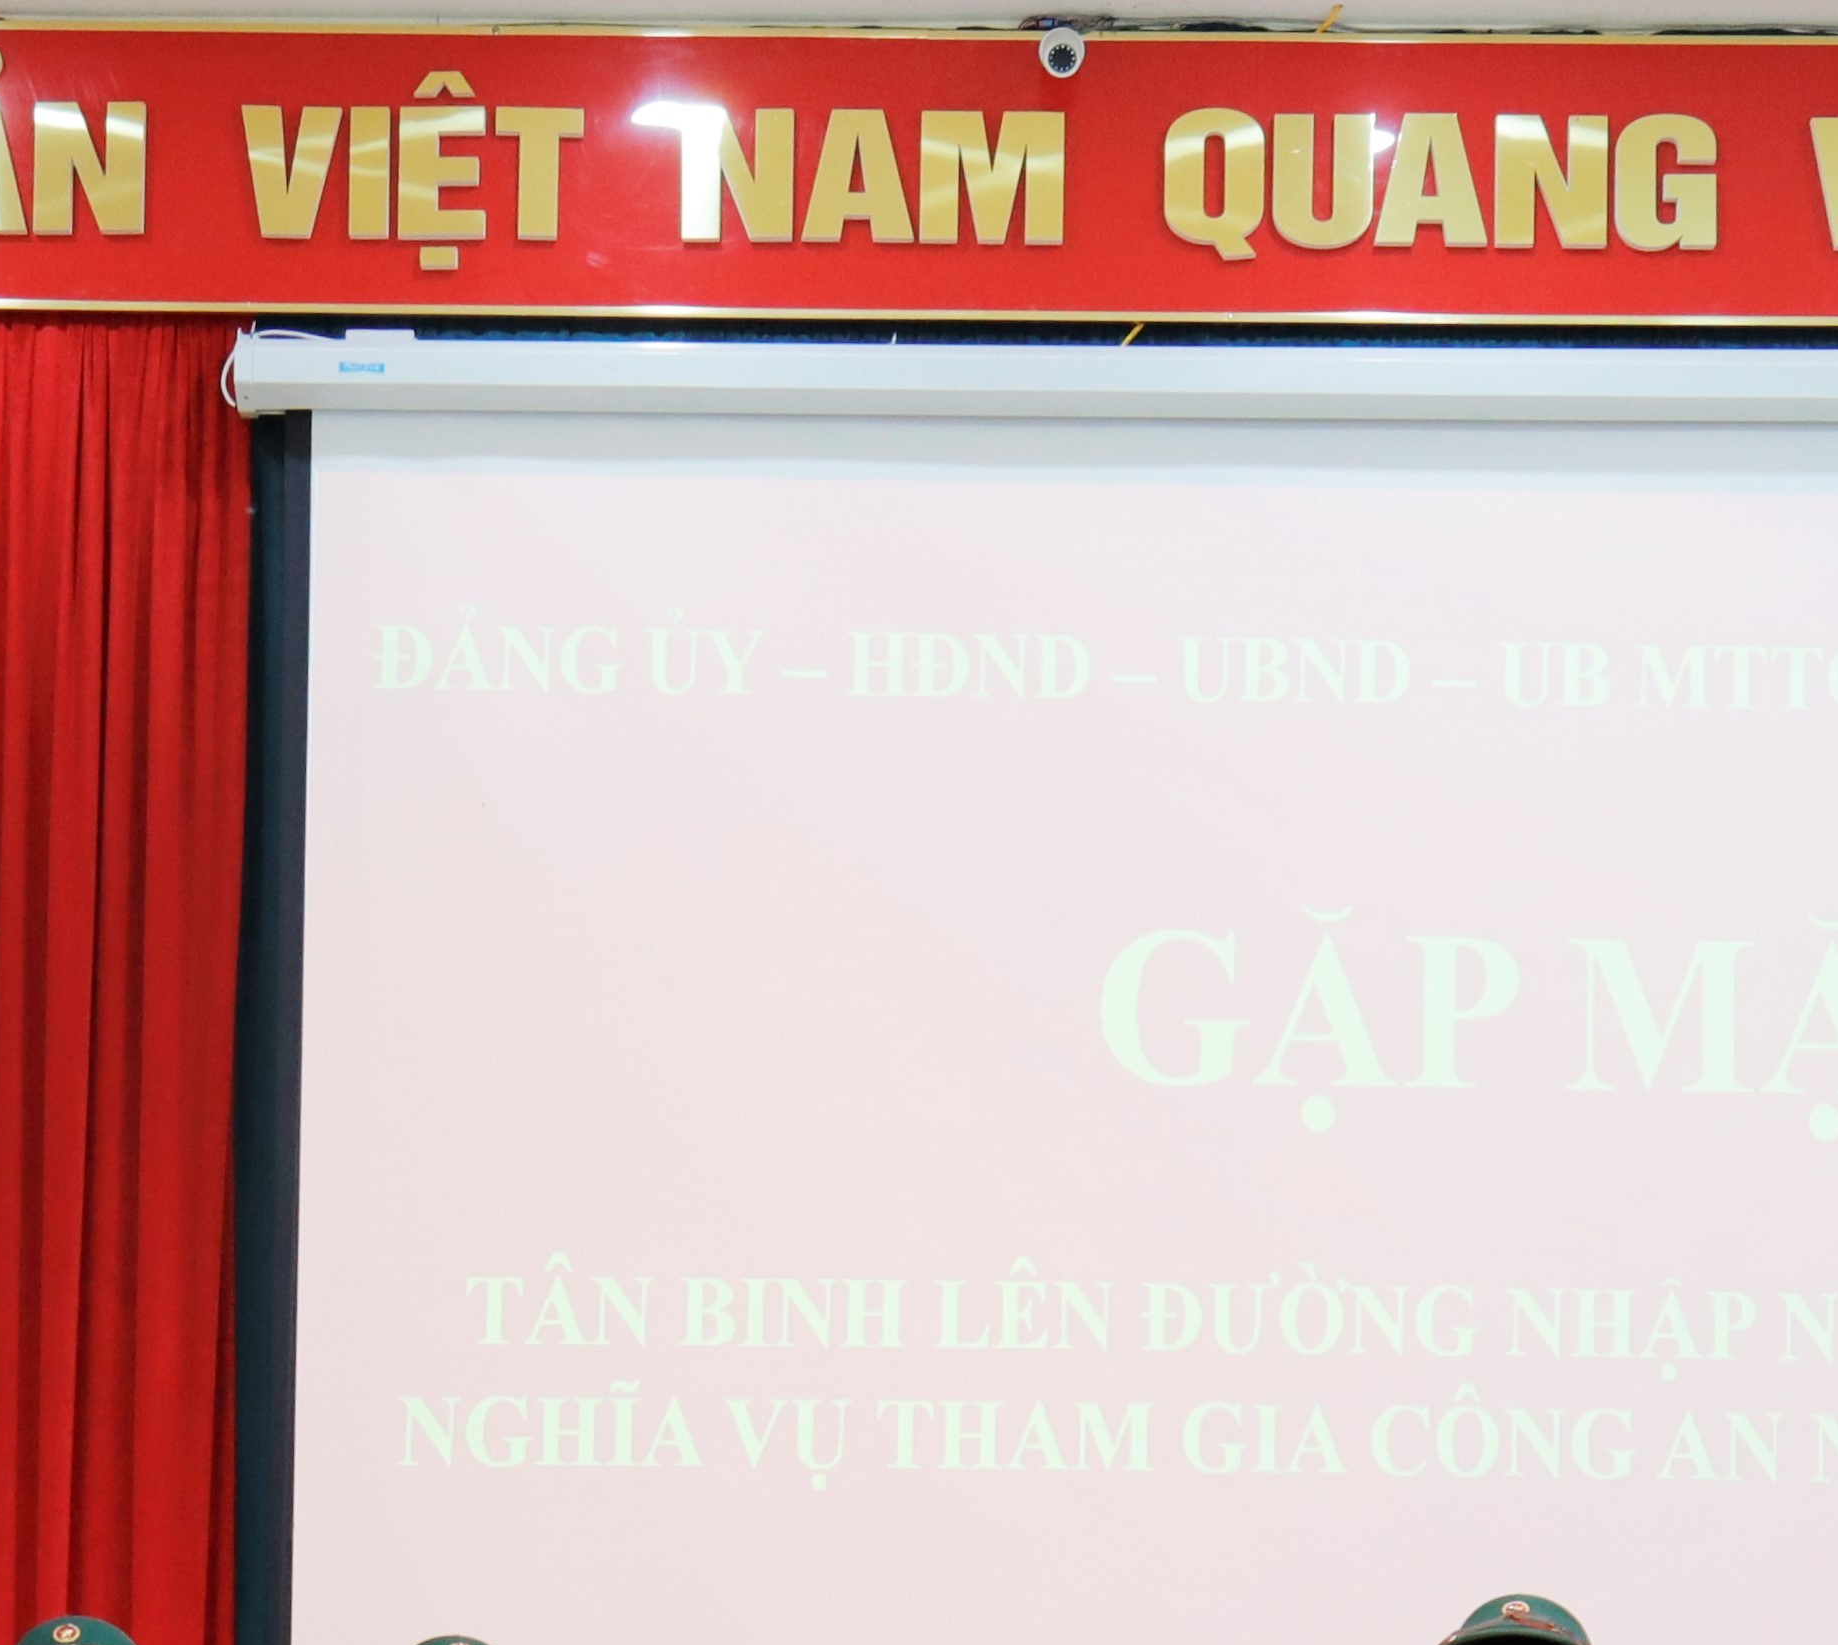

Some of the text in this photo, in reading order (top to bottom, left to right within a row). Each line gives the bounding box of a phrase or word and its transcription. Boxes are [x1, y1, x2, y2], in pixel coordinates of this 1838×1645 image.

[242, 71, 585, 270] VIỆT
[680, 104, 1065, 245] NAM
[1164, 107, 1717, 260] QUANG
[373, 603, 624, 697] ĐẢNG
[646, 602, 767, 698] ỦY
[848, 627, 1096, 703] HĐND
[1178, 634, 1415, 711] UBND
[1502, 641, 1612, 710] UB
[1097, 903, 1524, 1135] GẶP
[464, 1254, 657, 1348] TÂN
[679, 1273, 908, 1350] BINH
[933, 1257, 1117, 1353] LÊN
[1140, 1263, 1483, 1357] ĐƯỜNG
[1506, 1278, 1761, 1383] NHẬP
[395, 1381, 706, 1472] NGHĨA
[722, 1397, 854, 1493] VỤ
[875, 1398, 1156, 1475] THAM
[1180, 1399, 1349, 1478] GIA
[1369, 1390, 1639, 1483] CÔNG
[1656, 1409, 1784, 1484] AN
